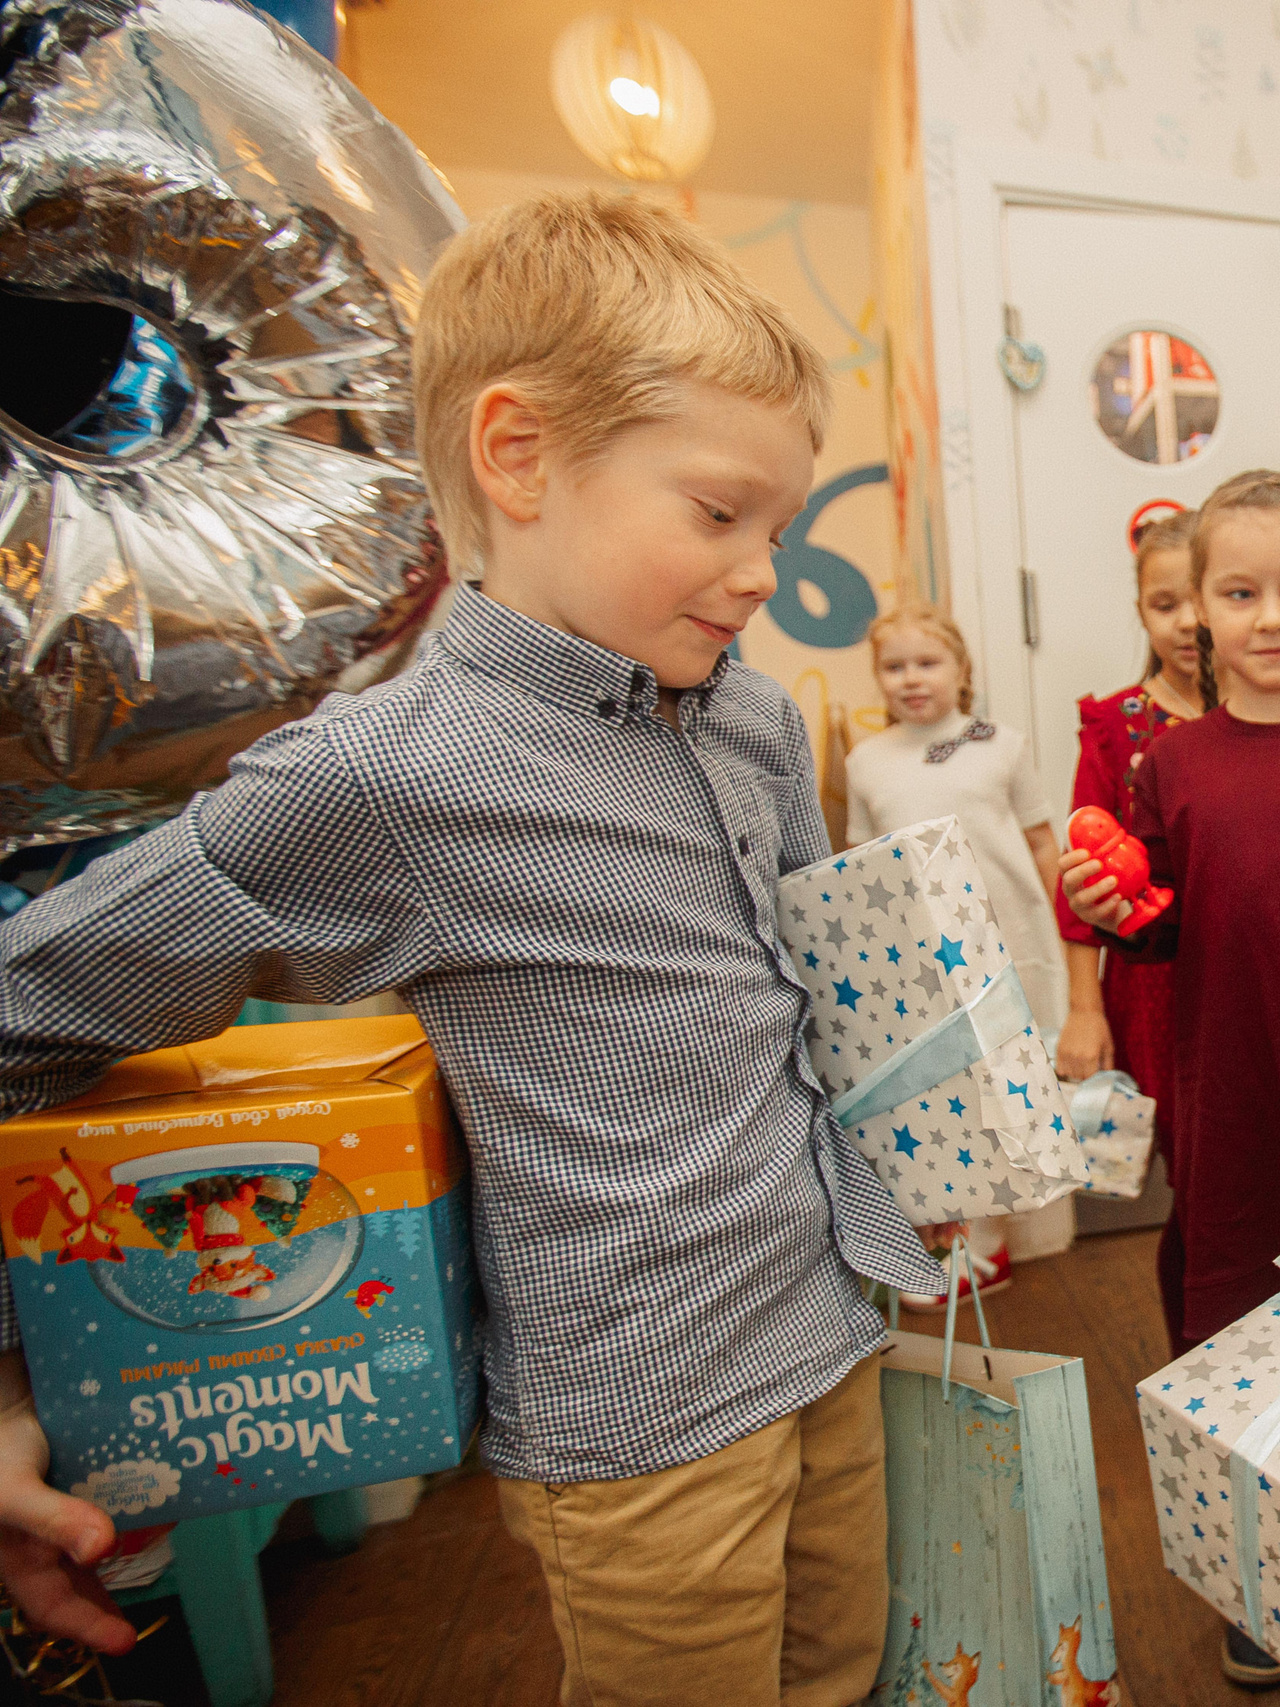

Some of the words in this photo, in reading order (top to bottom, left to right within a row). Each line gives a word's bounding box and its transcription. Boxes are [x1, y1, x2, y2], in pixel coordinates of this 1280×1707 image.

[207, 1343, 286, 1370] СВОИМИ
[294, 1331, 365, 1357] СКАЗКА
[119, 1357, 200, 1383] РУКАМИ
[129, 1361, 379, 1440] Moments
[177, 1411, 353, 1468] Magic
